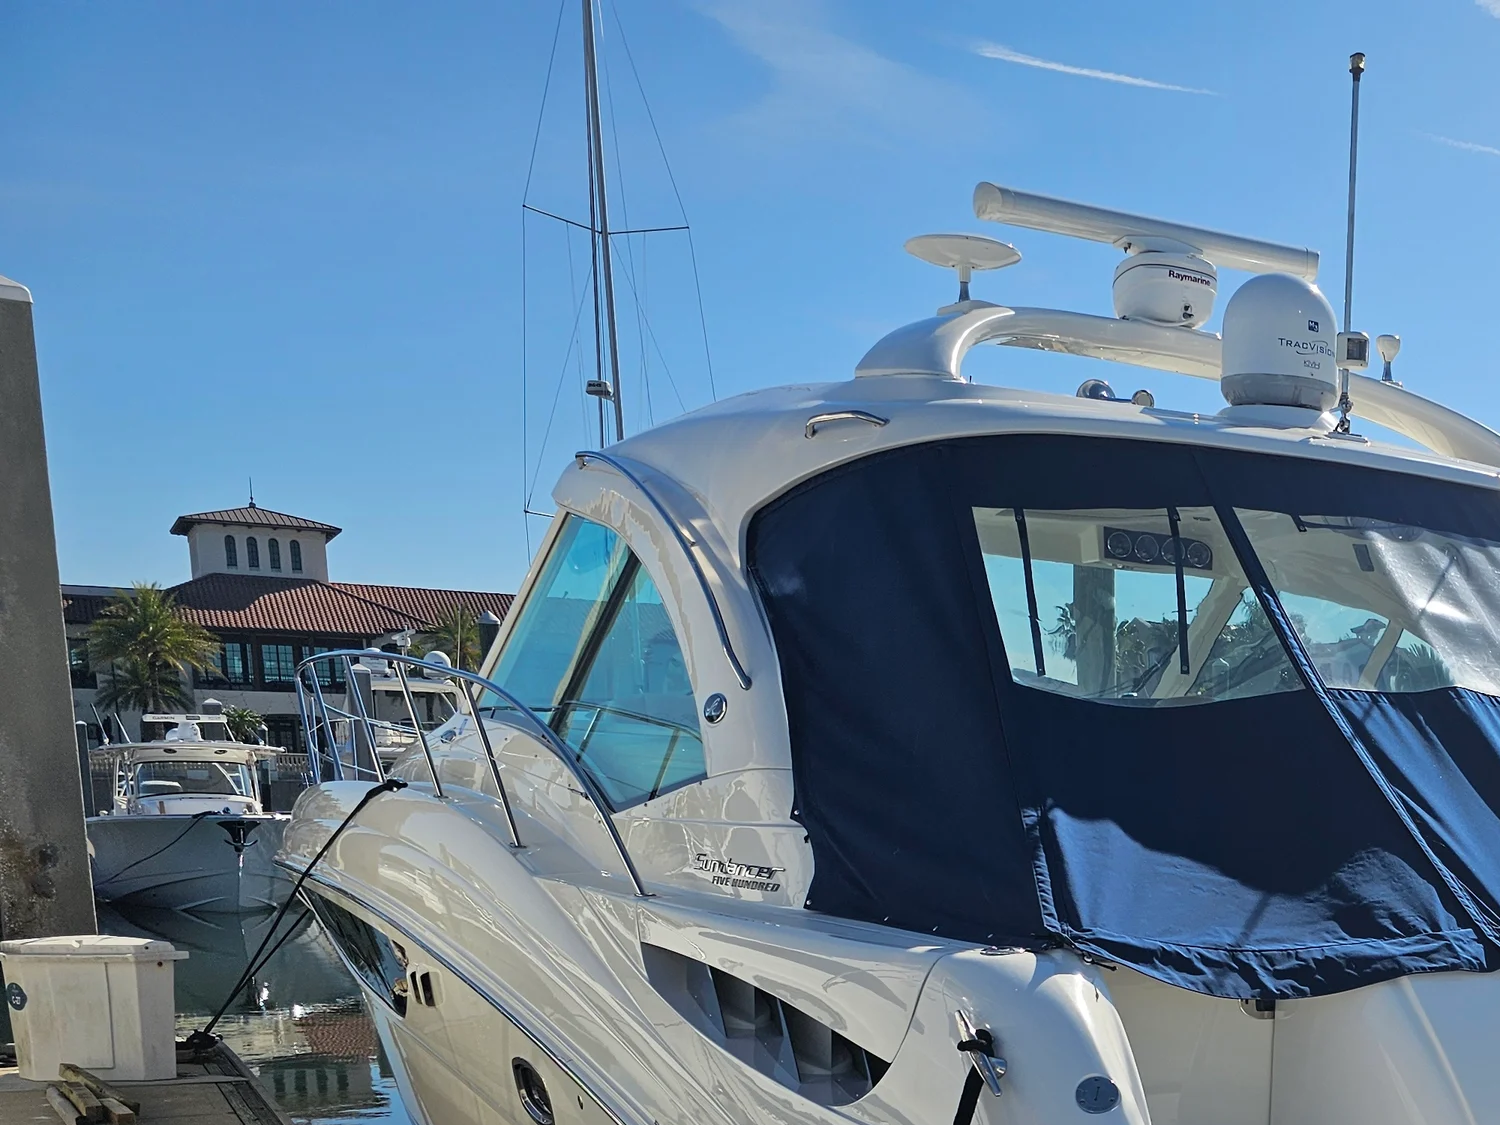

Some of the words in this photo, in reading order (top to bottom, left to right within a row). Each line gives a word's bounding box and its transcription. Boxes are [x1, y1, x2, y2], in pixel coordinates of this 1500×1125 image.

[1168, 269, 1211, 286] Raymarine
[712, 875, 731, 887] FIVE
[732, 878, 780, 893] HUNDRED
